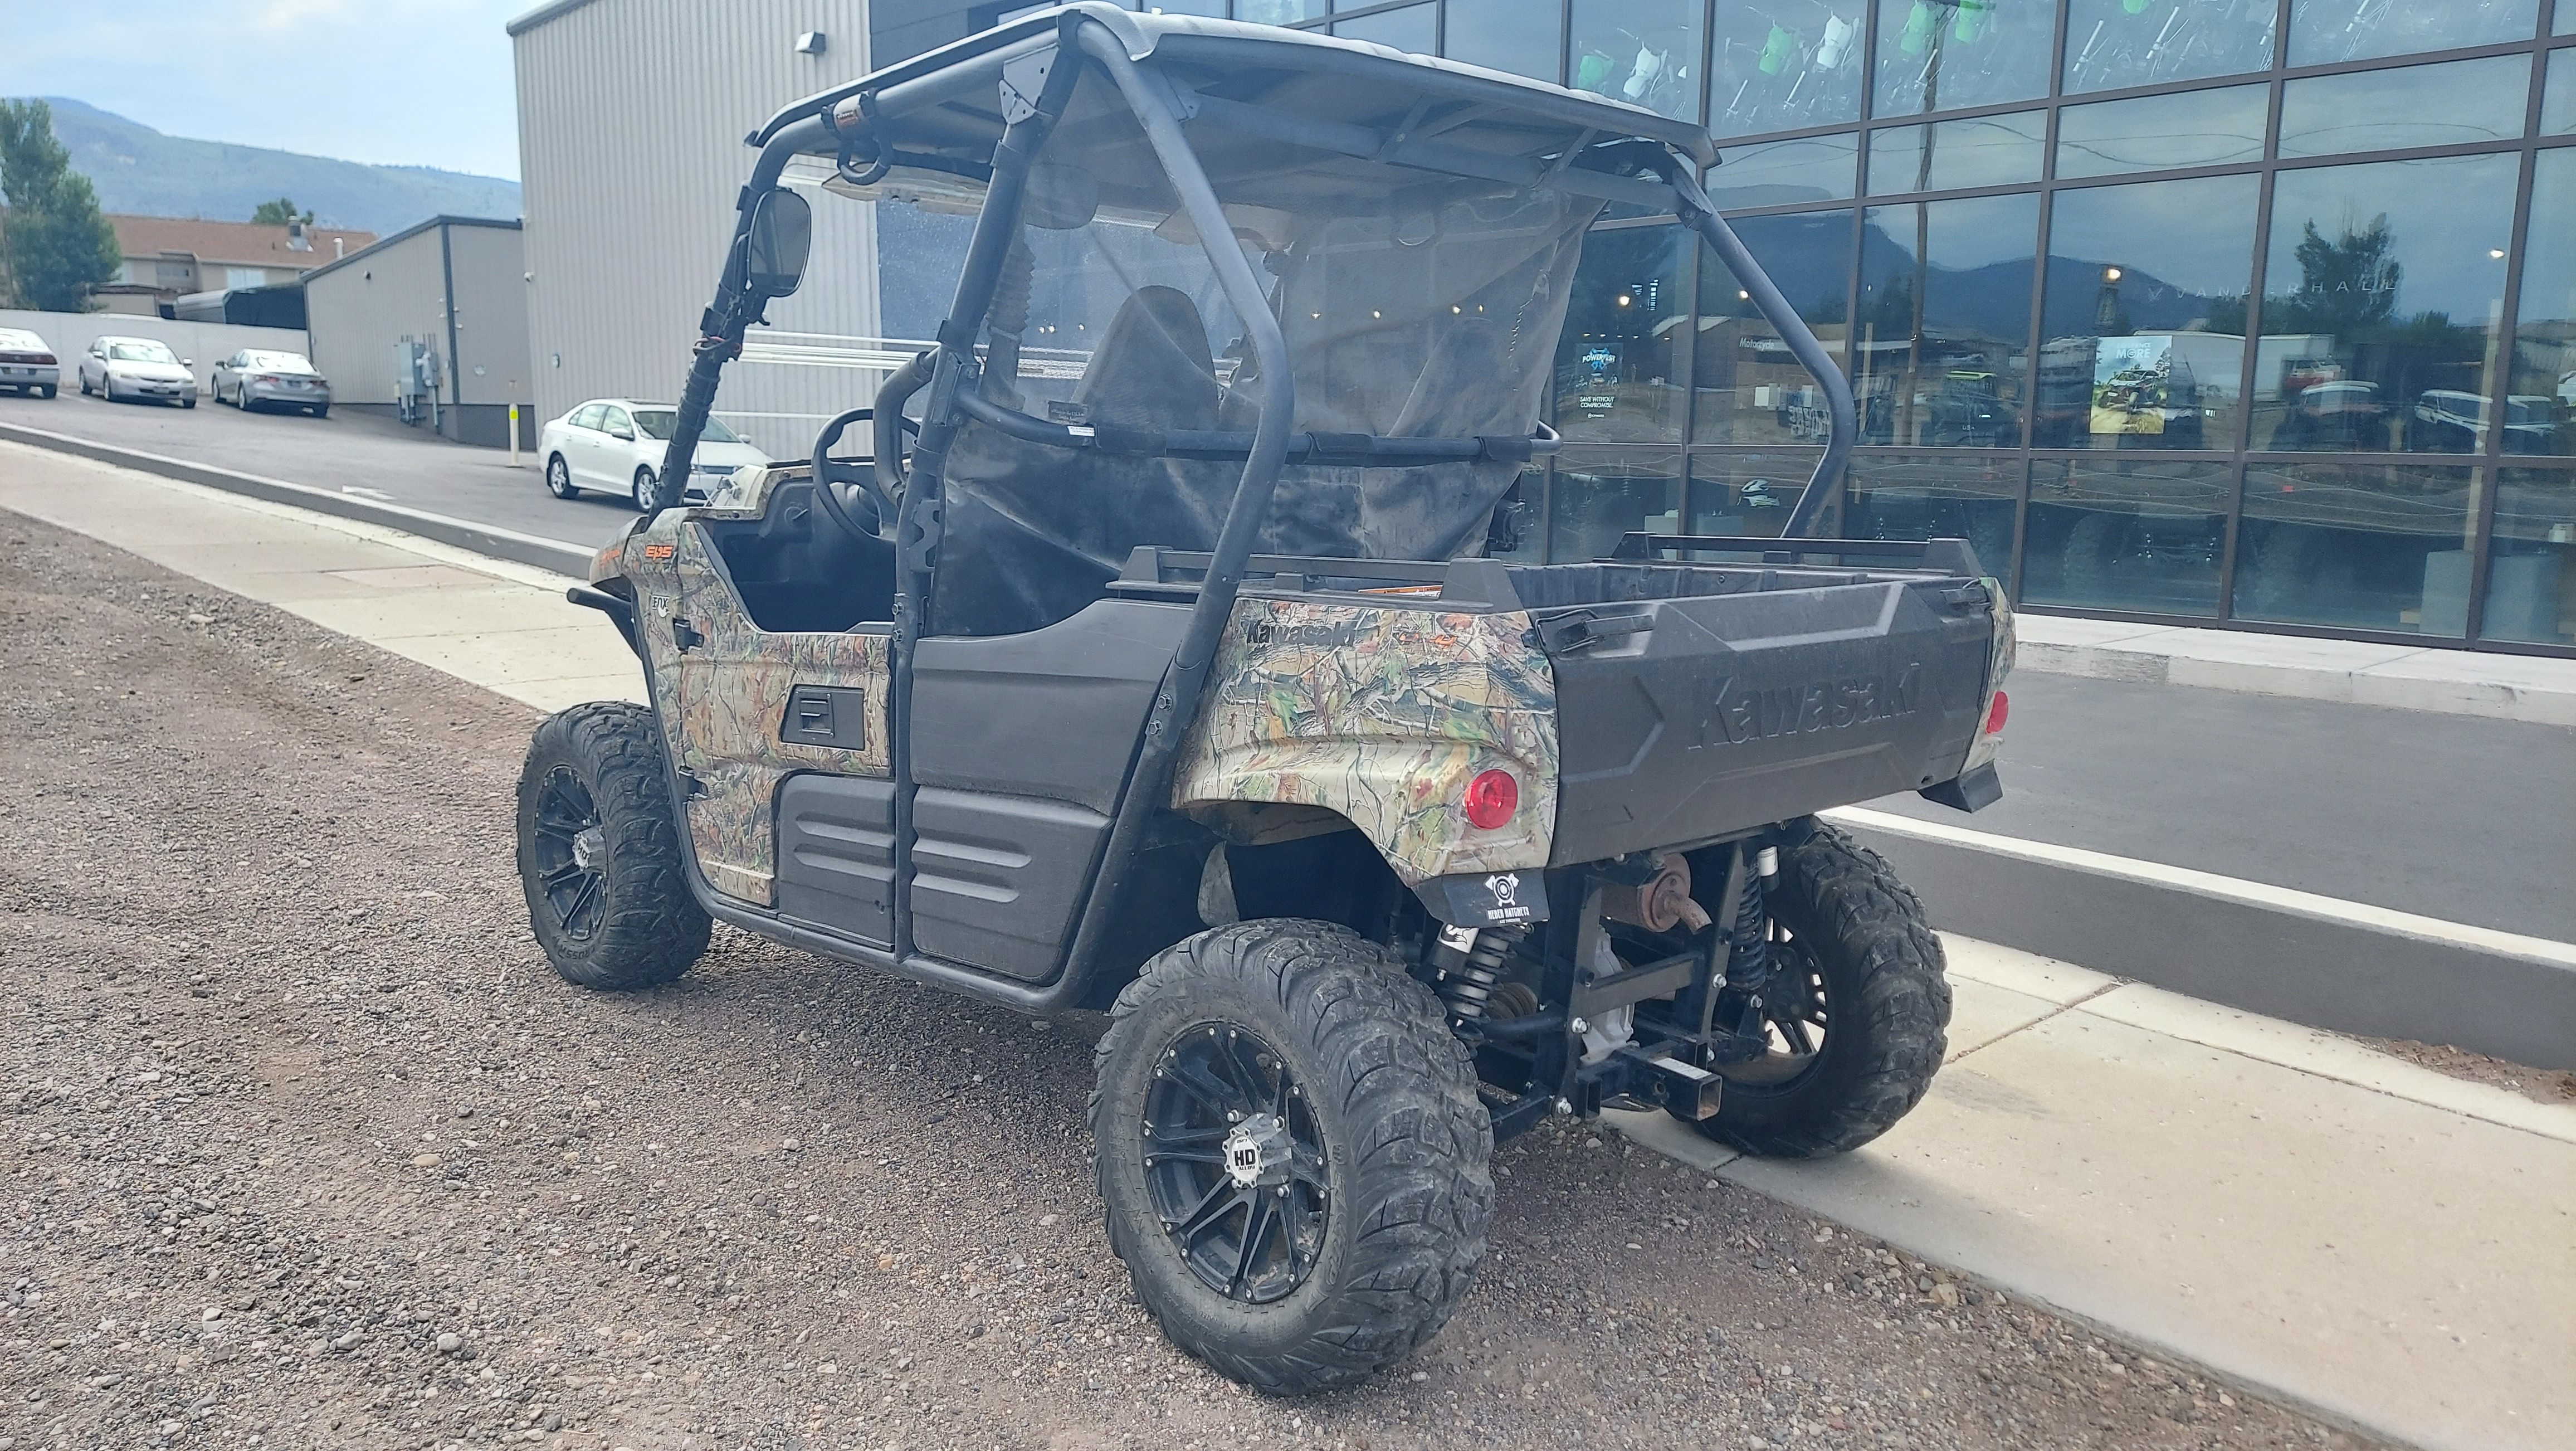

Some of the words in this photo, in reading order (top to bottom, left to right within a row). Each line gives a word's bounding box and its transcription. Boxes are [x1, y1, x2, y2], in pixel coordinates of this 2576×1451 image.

[1582, 353, 1616, 363] POWERFEST
[645, 546, 674, 562] EPS
[652, 596, 669, 609] FOX
[1247, 620, 1356, 646] Kawasaki
[1688, 662, 1921, 749] Kawasaki
[1487, 909, 1505, 919] HEBER
[1505, 906, 1530, 918] HATCHETS
[1234, 1148, 1256, 1166] HD
